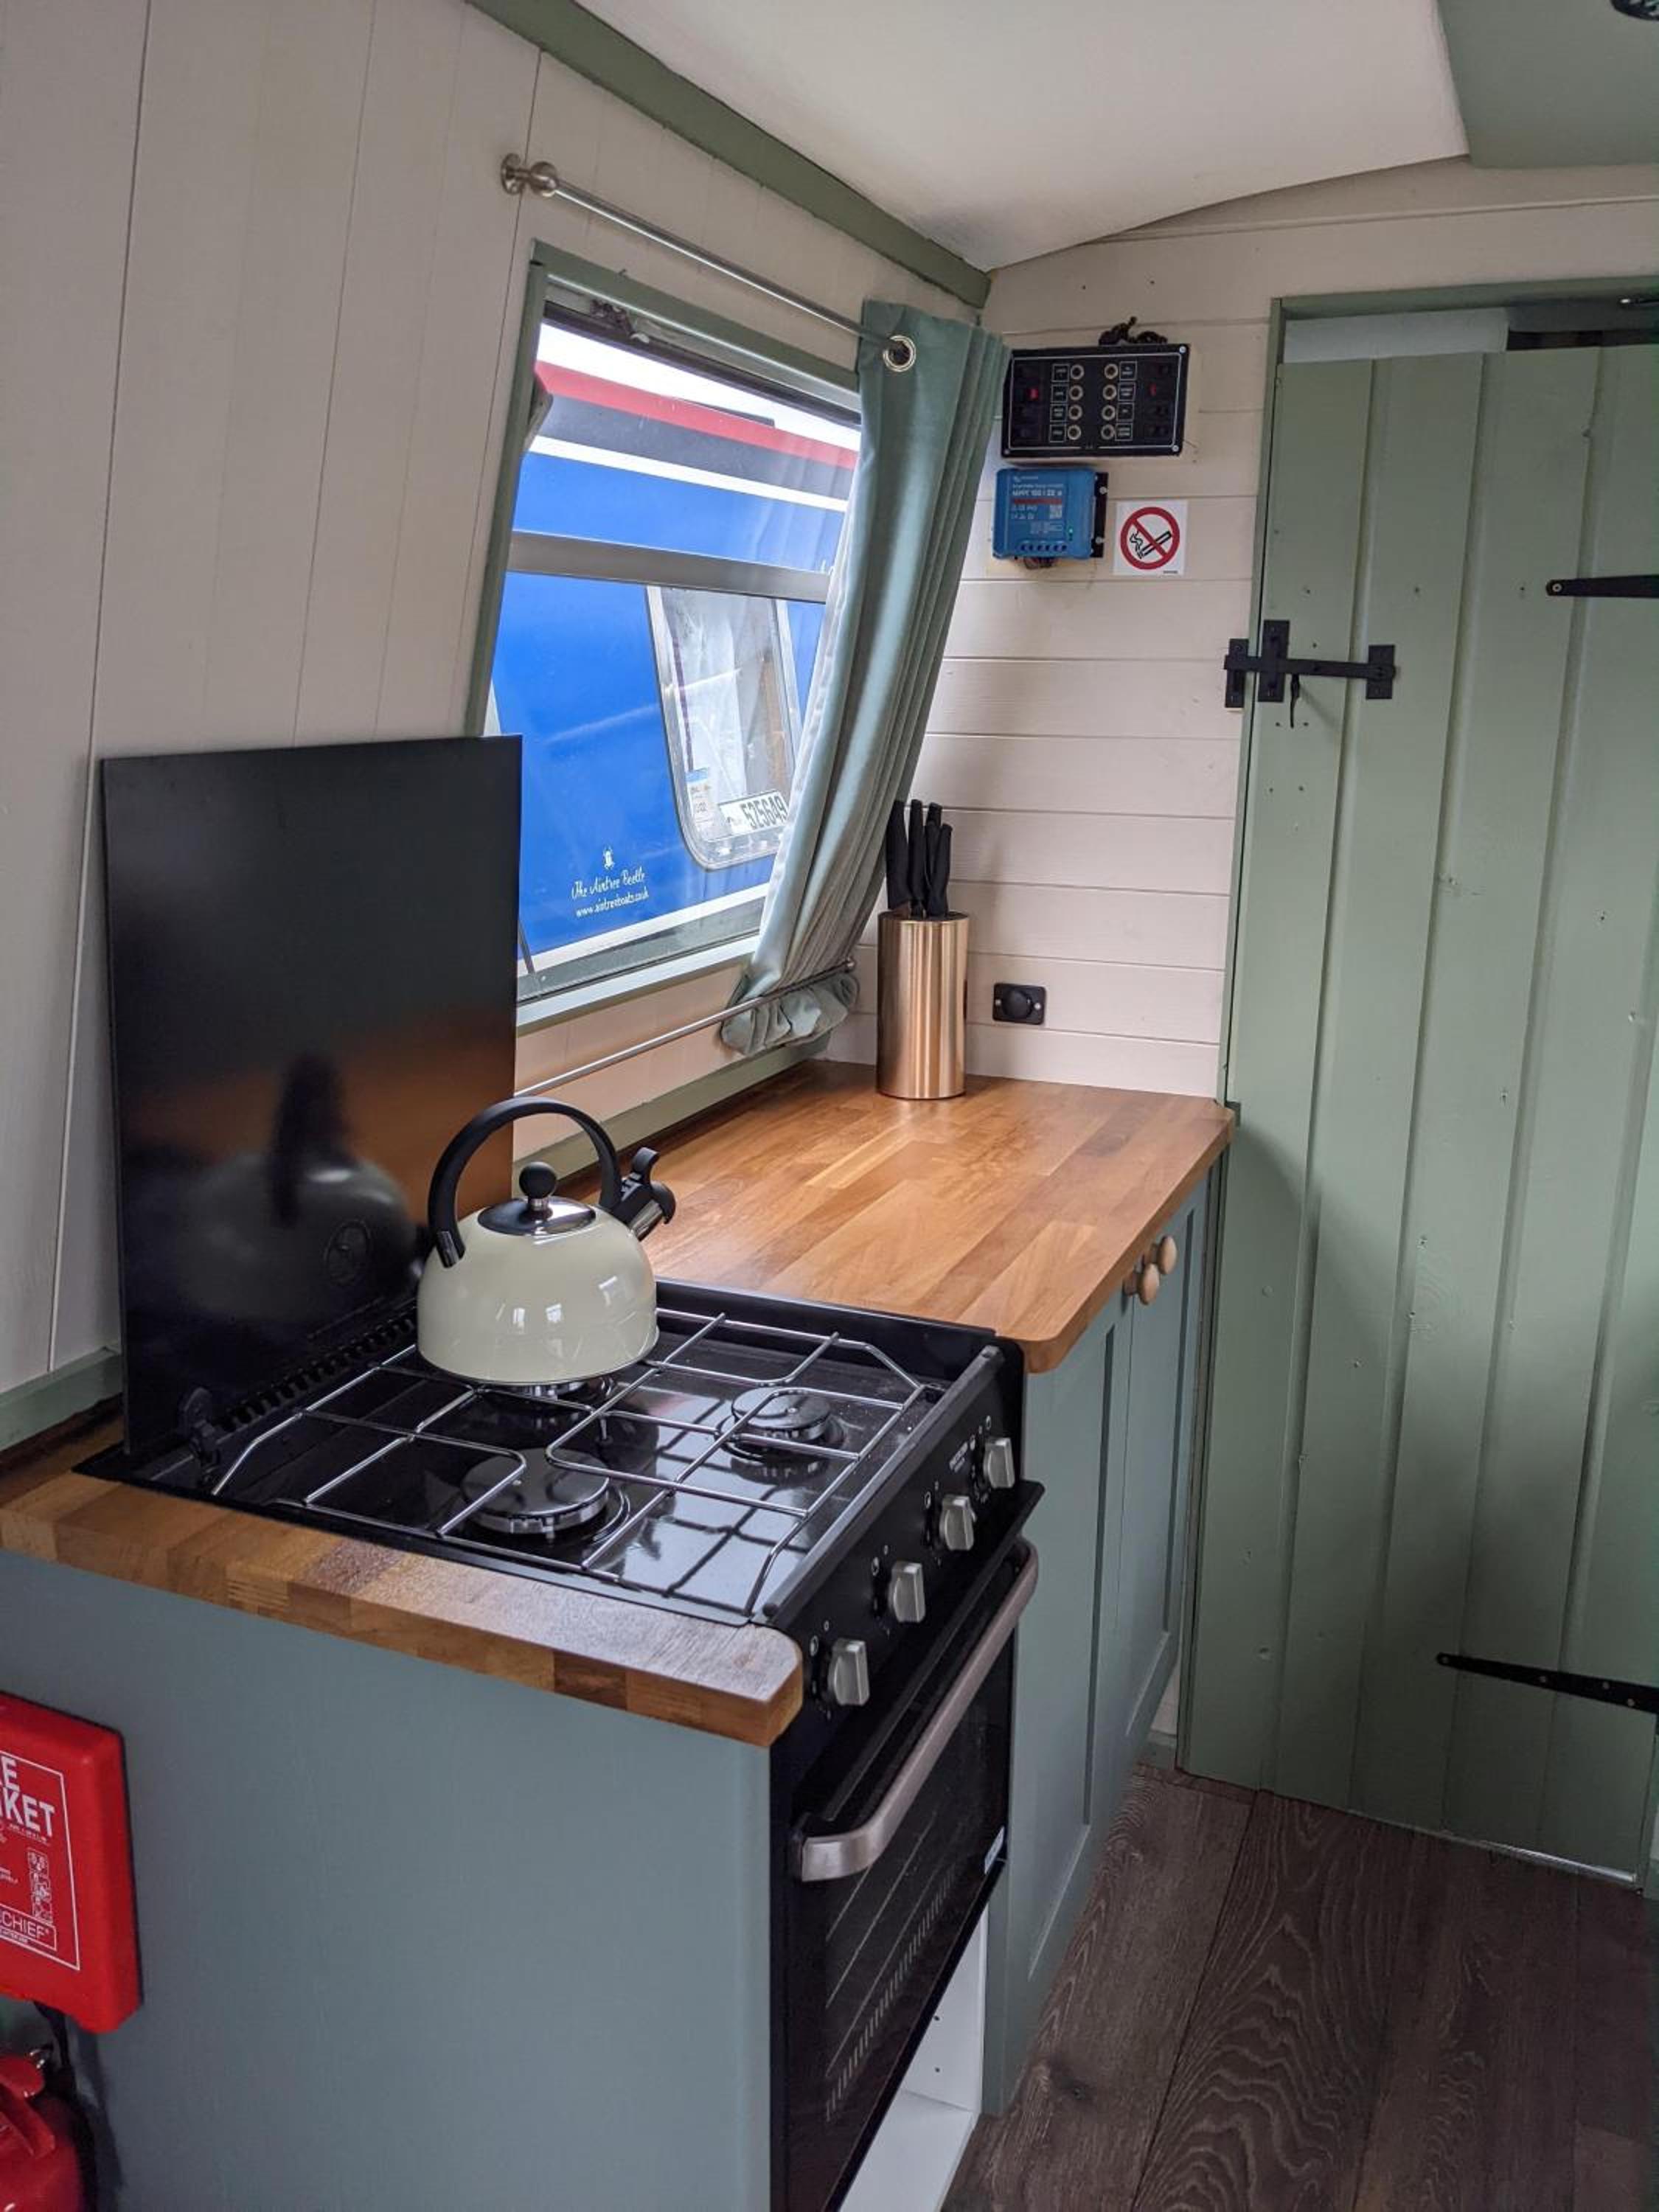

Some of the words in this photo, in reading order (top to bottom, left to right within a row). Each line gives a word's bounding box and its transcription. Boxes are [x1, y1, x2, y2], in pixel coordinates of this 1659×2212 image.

[571, 879, 588, 899] The
[0, 1755, 20, 1792] E
[0, 1786, 56, 1837] KET
[0, 1910, 46, 1939] CHIEF
